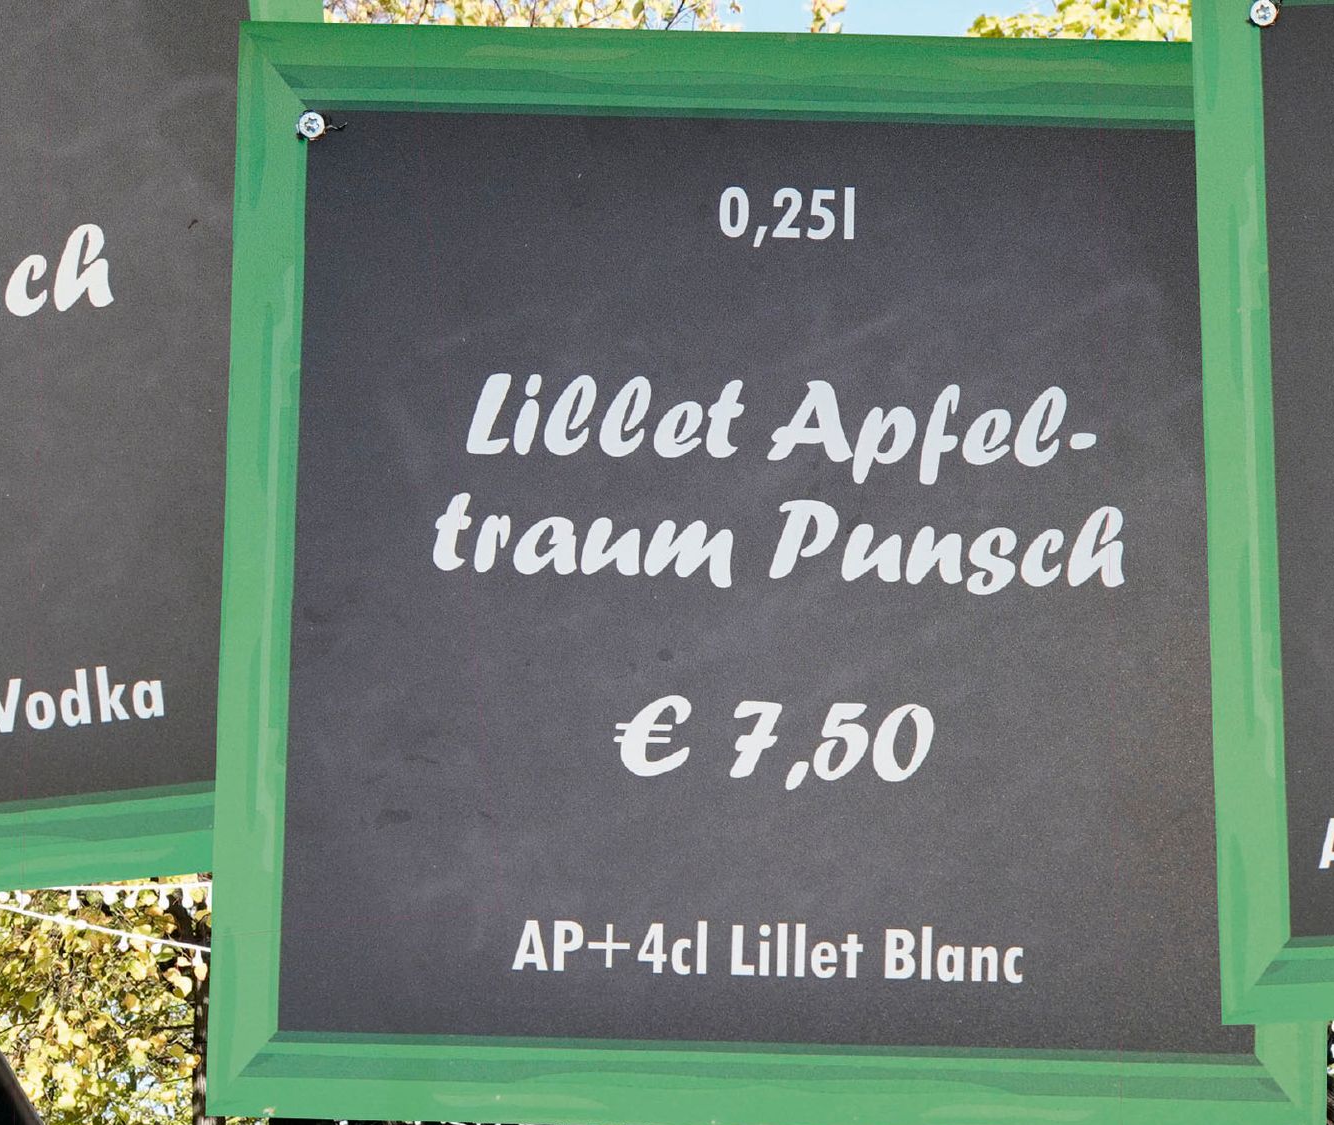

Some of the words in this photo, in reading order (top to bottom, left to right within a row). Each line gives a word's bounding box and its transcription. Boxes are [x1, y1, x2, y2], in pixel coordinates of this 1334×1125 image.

[719, 186, 856, 248] 0,25l
[465, 372, 745, 459] Lillet
[766, 379, 1097, 486] Apfel-
[432, 492, 734, 589] traum
[768, 499, 1125, 596] Punsch
[612, 694, 693, 777] €
[729, 700, 936, 791] 7,50
[511, 919, 708, 976] AP+4cl
[730, 922, 864, 979] Lillet
[884, 925, 1024, 984] Blanc
